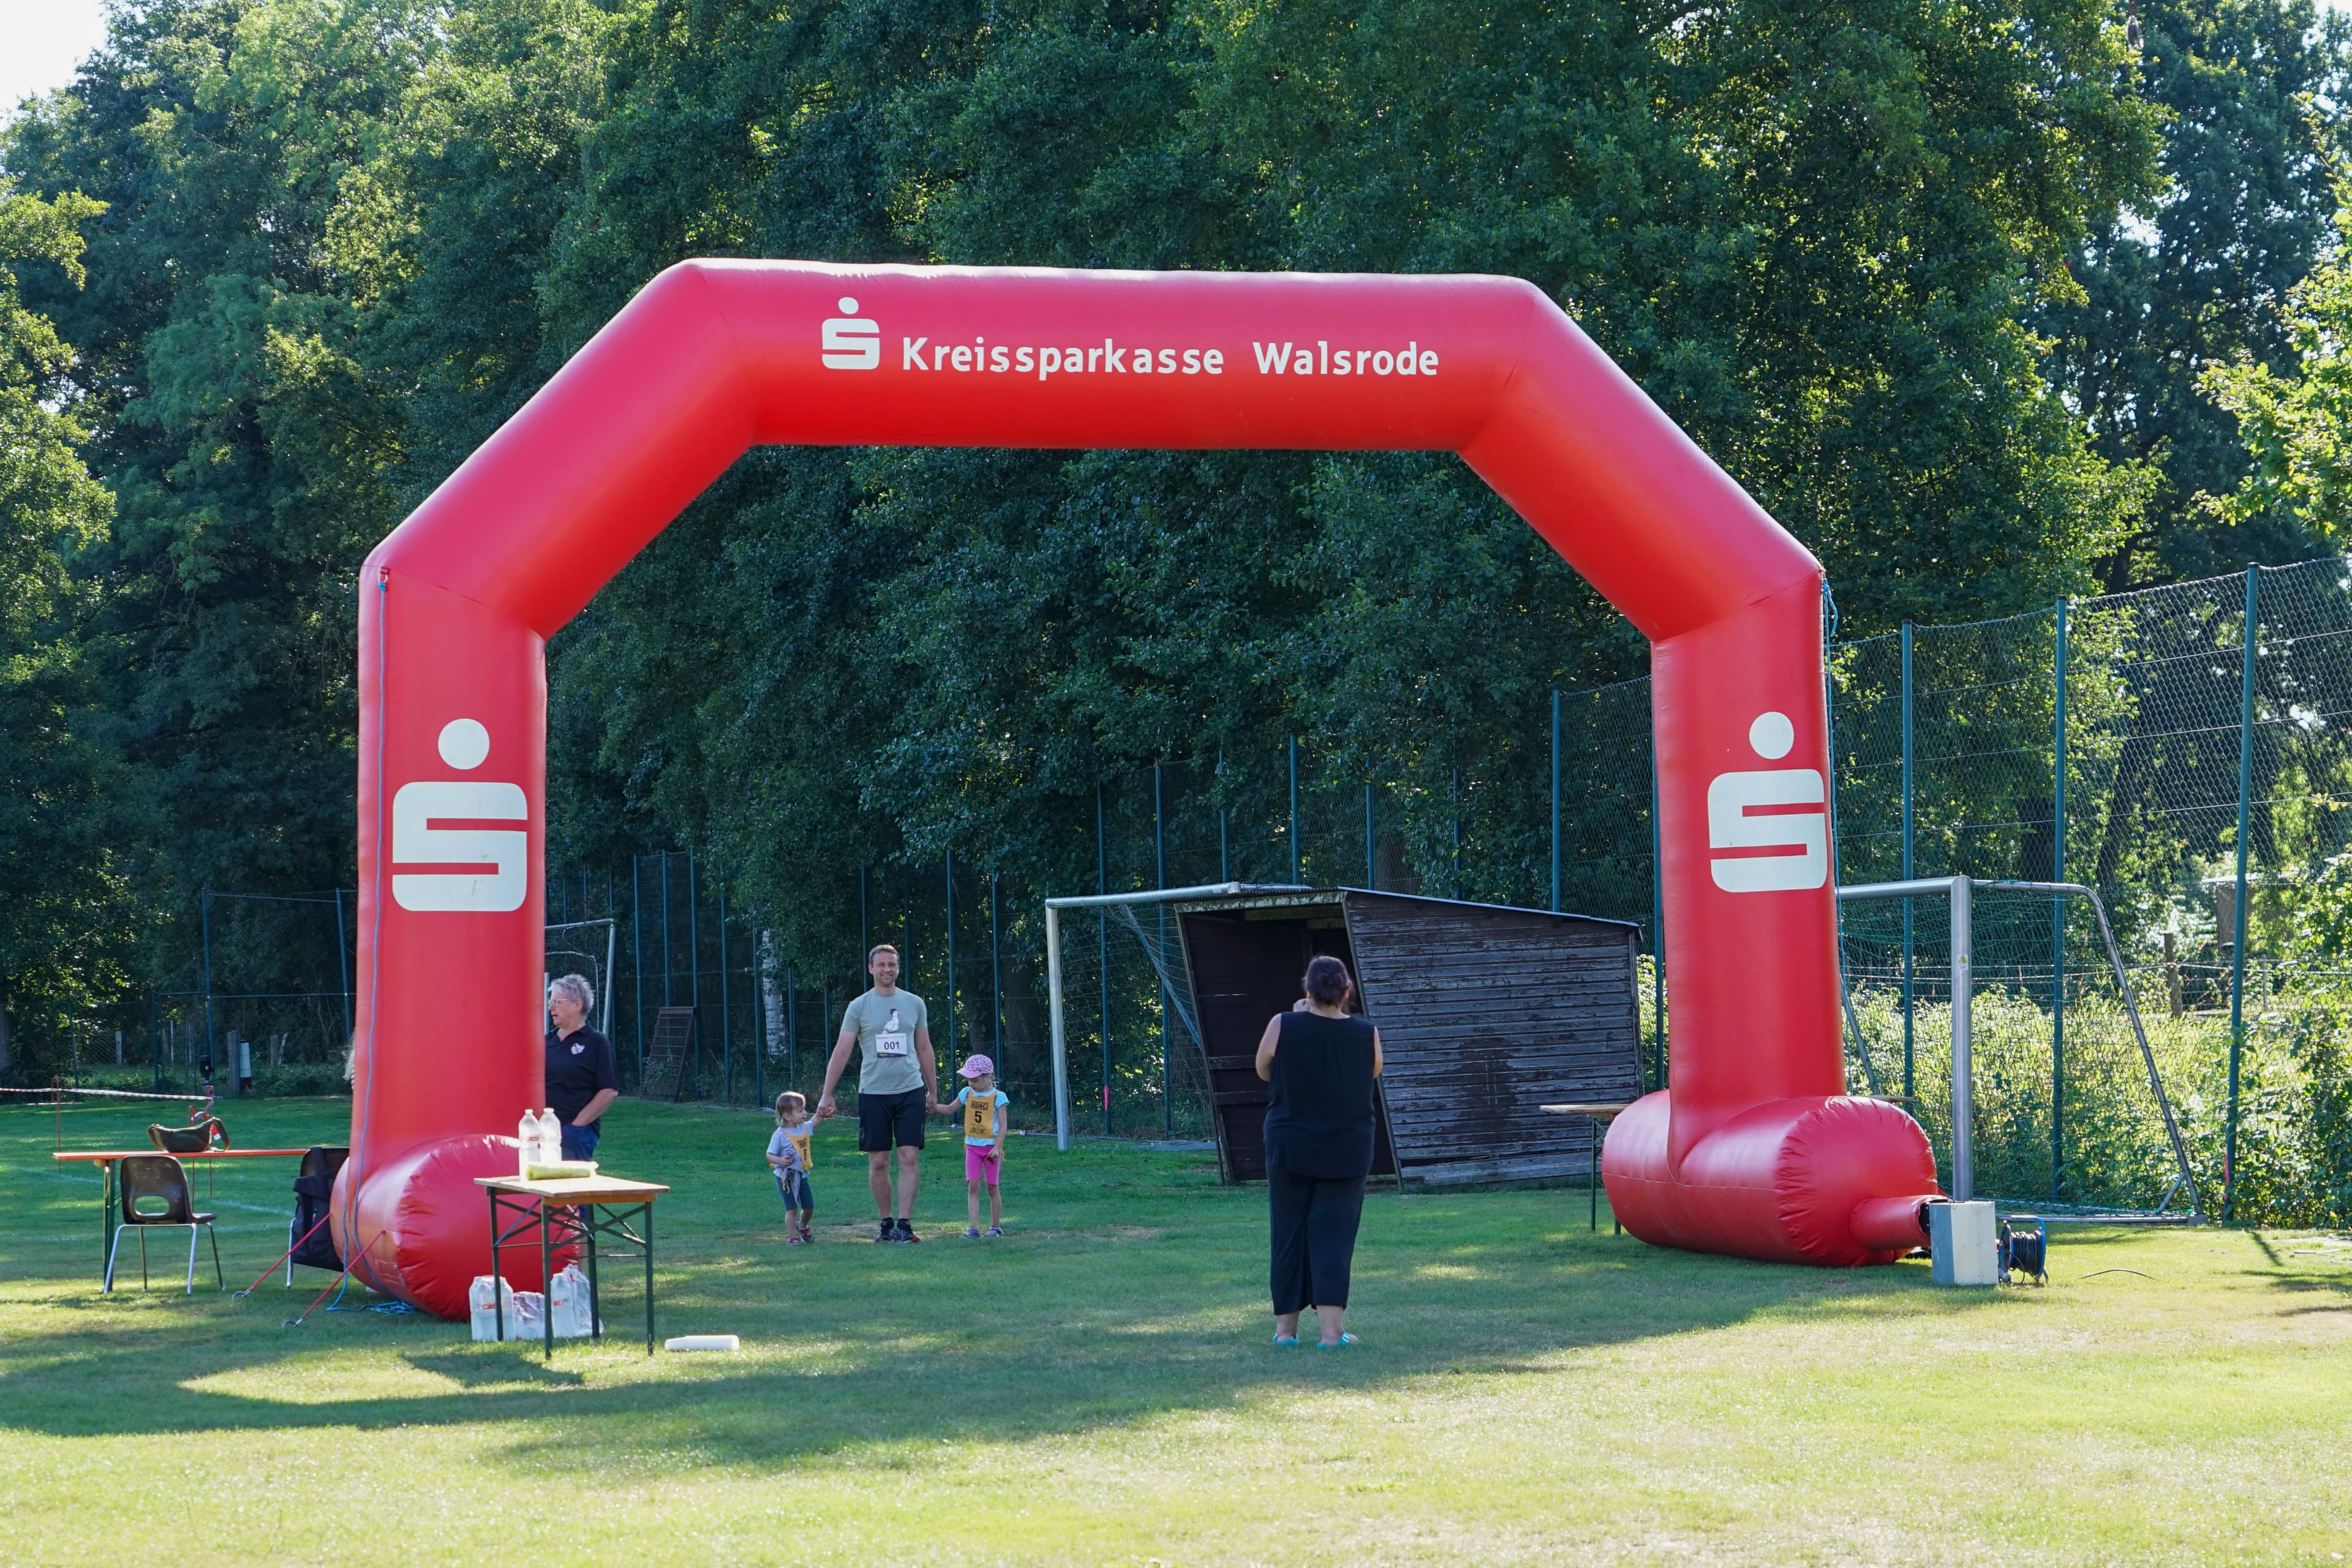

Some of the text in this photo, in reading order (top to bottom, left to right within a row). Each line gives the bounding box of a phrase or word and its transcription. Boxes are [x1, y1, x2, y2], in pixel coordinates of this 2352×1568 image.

[903, 336, 1439, 381] Kreissparkasse Walsrode
[884, 1041, 900, 1050] 001
[974, 1110, 982, 1123] 5
